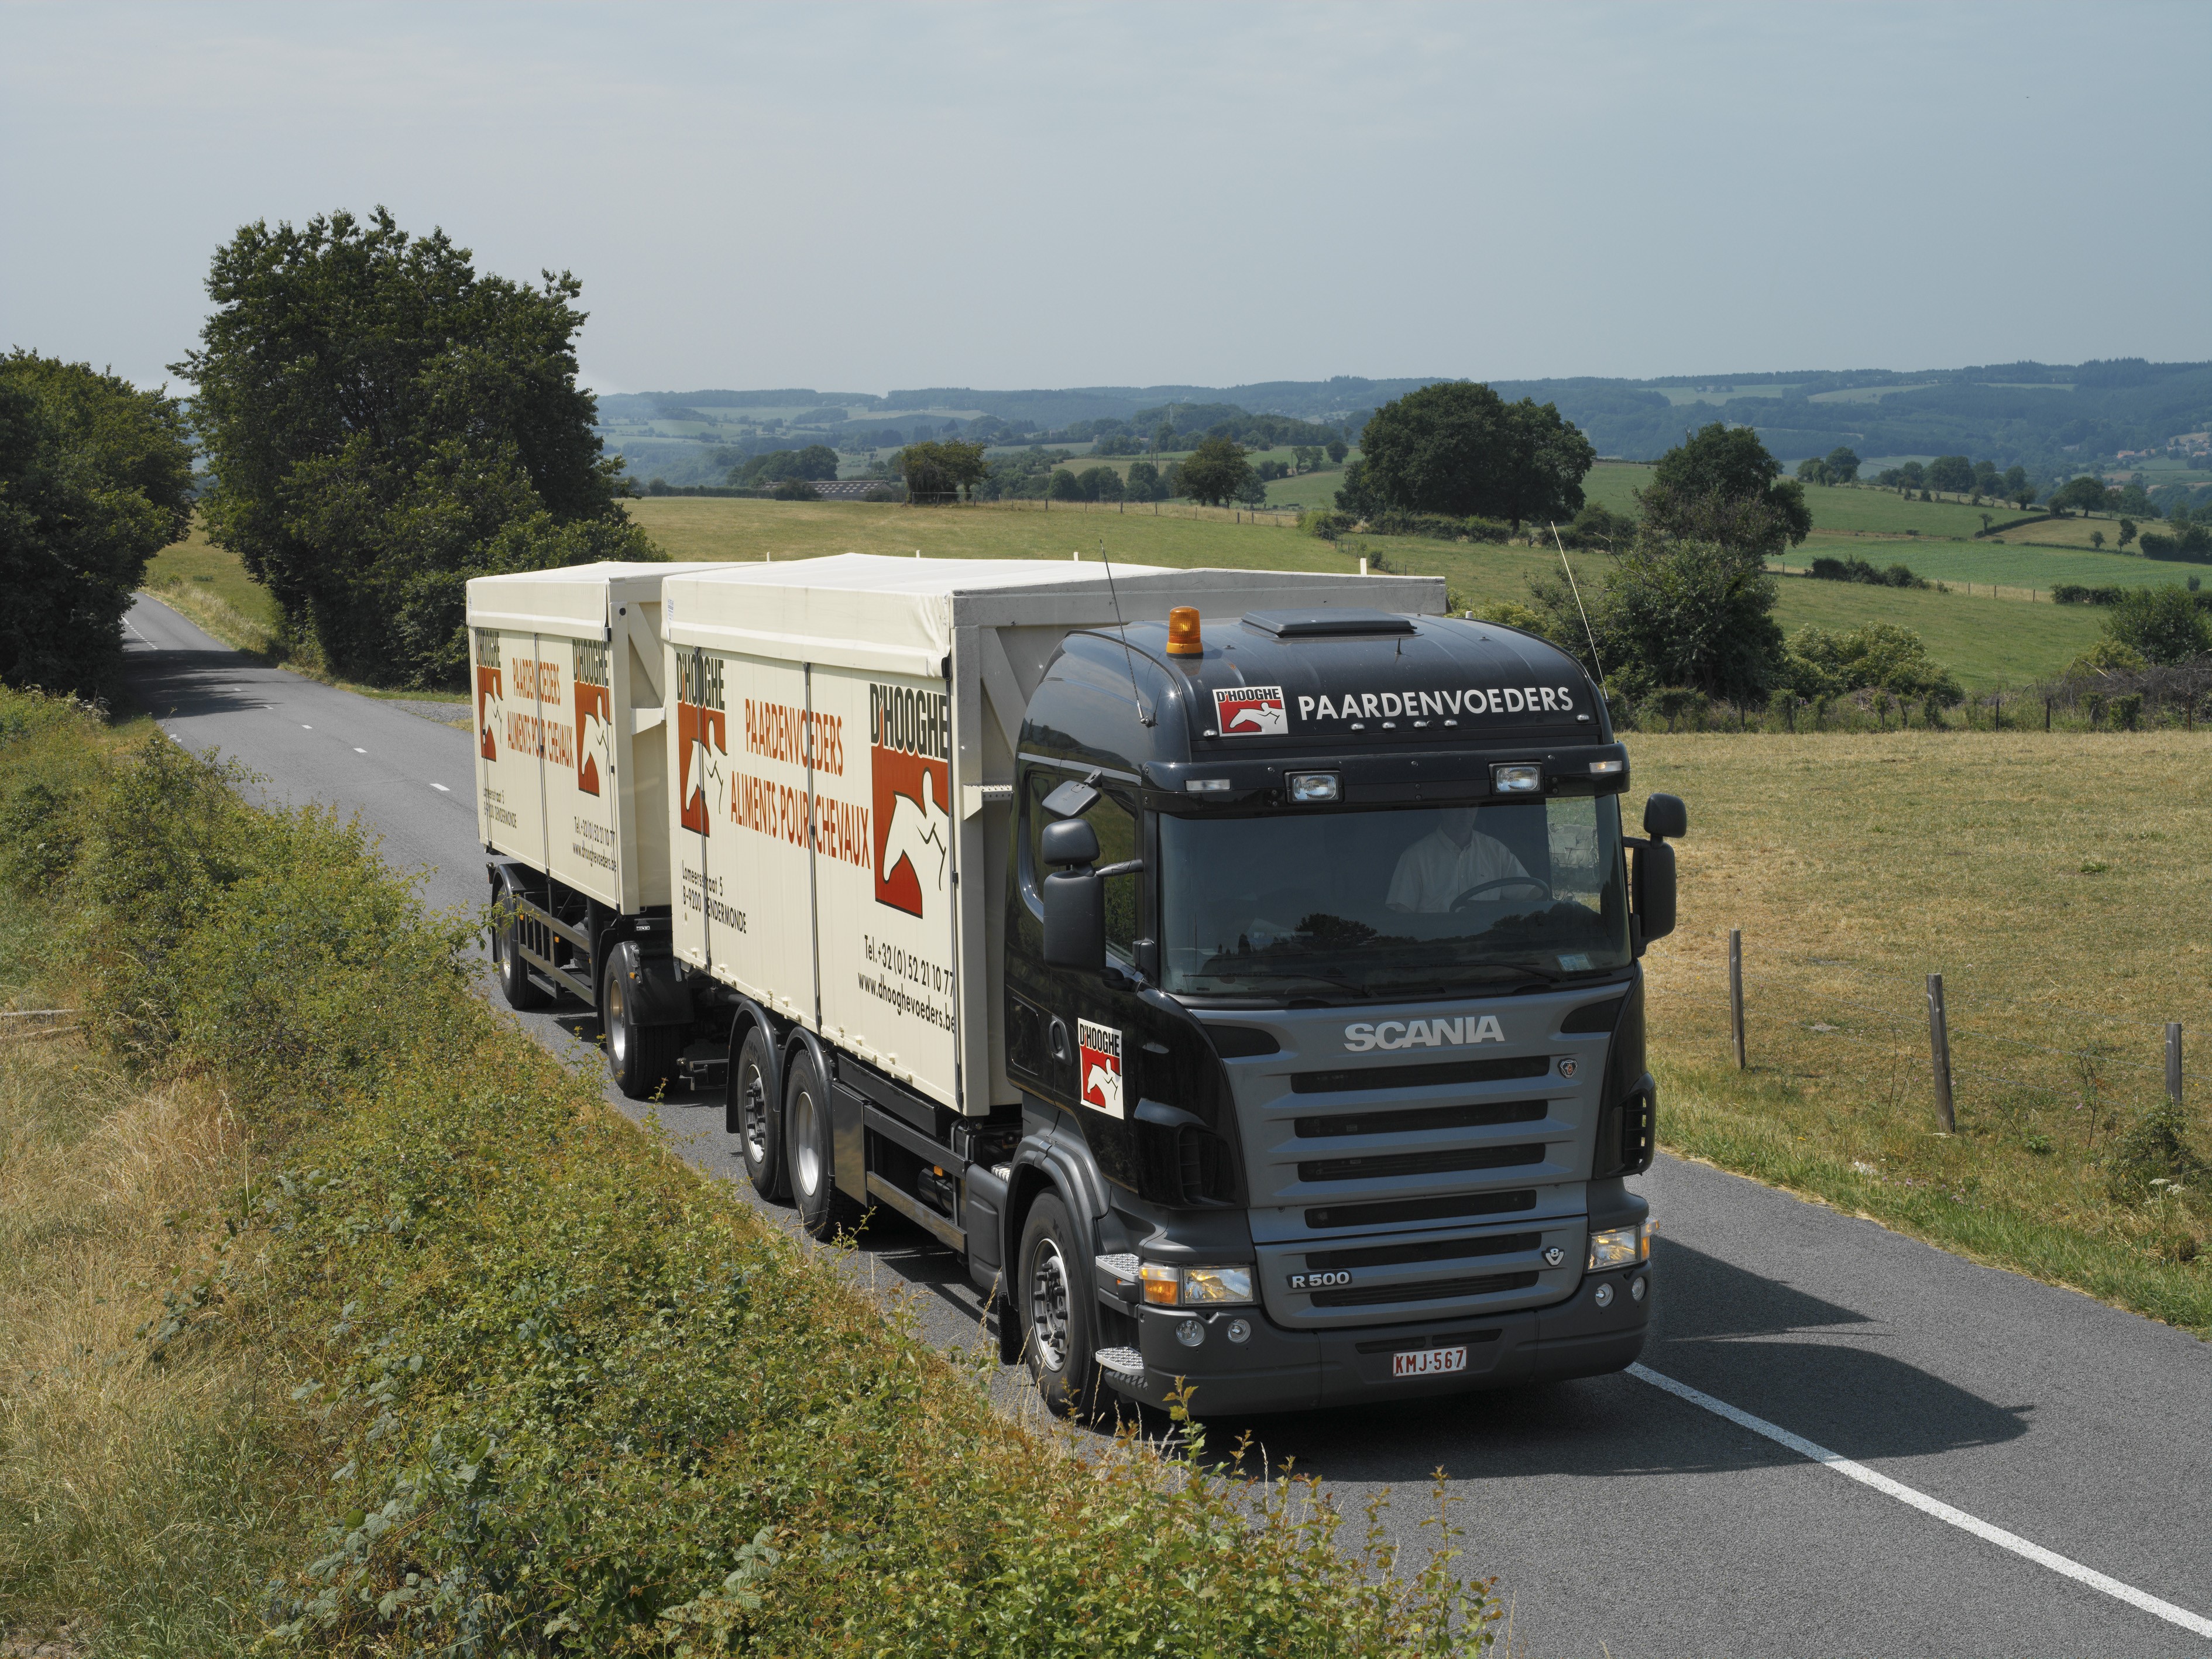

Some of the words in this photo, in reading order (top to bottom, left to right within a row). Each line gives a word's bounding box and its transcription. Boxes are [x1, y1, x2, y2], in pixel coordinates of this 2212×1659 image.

[572, 638, 609, 687] D'HOOGHE
[676, 652, 725, 711] D'HOOGHE
[1215, 688, 1281, 702] D'HOOGHE
[1297, 686, 1574, 721] PAARDENVOEDERS
[507, 710, 531, 755] ALIMENTS
[548, 720, 574, 769] CHEVAUX
[745, 698, 843, 777] PAARDENVOEDERS
[870, 683, 948, 760] D'HOOGHE
[731, 770, 777, 839] ALIMENTS
[779, 784, 811, 850] POUR
[815, 794, 871, 870] CHEVAUX
[683, 885, 702, 913] B-9200
[719, 876, 723, 897] 5
[908, 954, 919, 983] 52
[921, 959, 930, 988] 21
[932, 964, 942, 992] 10
[943, 968, 953, 998] 77
[858, 972, 954, 1035] www.dhooghevoeders.be
[1079, 1023, 1120, 1057] D'HOOGHE
[1344, 1015, 1505, 1052] SCANIA
[1292, 1275, 1306, 1289] R
[1308, 1271, 1350, 1287] 500
